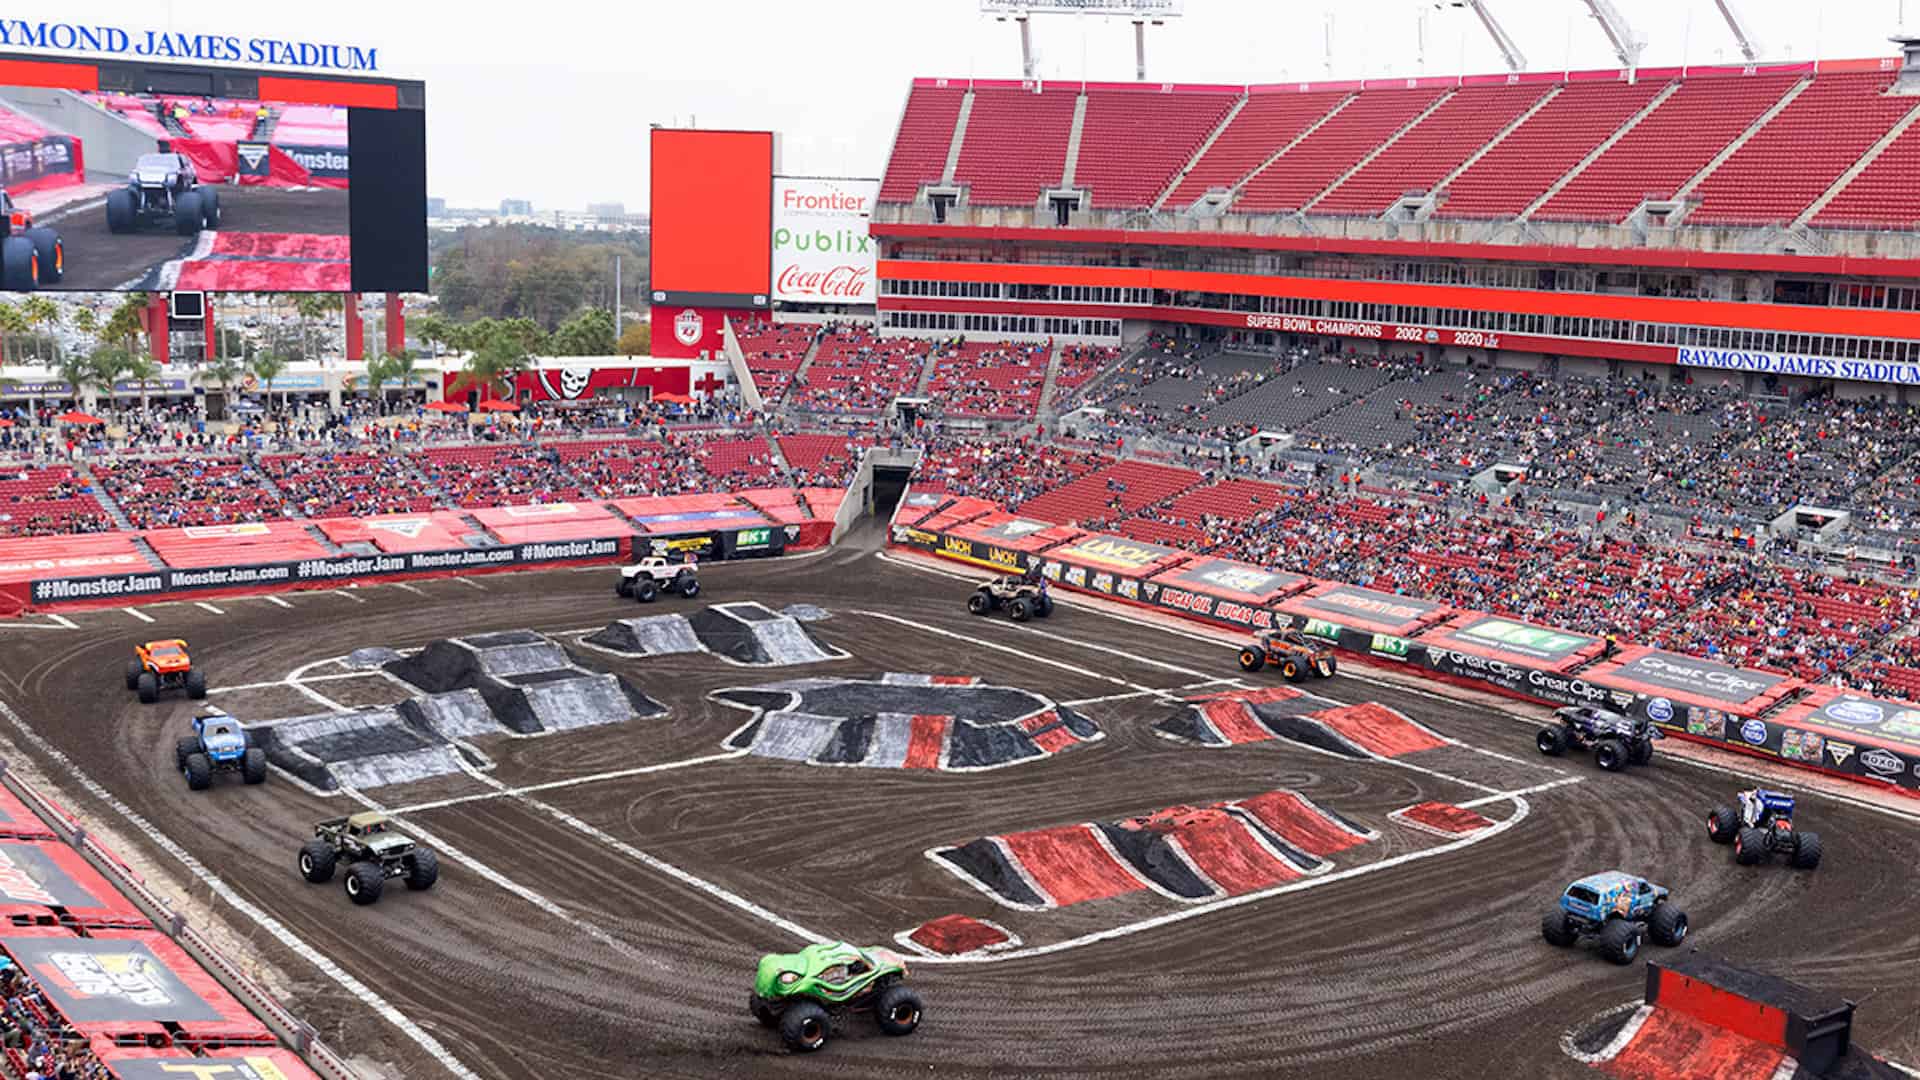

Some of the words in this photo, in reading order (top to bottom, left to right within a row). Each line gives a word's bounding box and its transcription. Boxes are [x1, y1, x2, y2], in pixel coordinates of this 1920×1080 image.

[135, 30, 242, 62] JAMES
[248, 38, 378, 71] STADIUM
[783, 189, 867, 210] Frontier
[1247, 315, 1281, 329] SUPER
[1283, 318, 1314, 332] BOWL
[1316, 321, 1382, 337] CHAMPIONS
[1395, 326, 1423, 341] 2002
[1454, 331, 1483, 345] 2020
[1679, 348, 1771, 372] RAYMOND
[1773, 355, 1836, 376] JAMES
[522, 540, 616, 561] #MonsterJam
[737, 530, 770, 545] BKT
[412, 550, 514, 568] MonsterJam.com
[944, 535, 973, 557] UNOH
[989, 546, 1018, 567] UNOH
[171, 566, 289, 586] MonsterJam.com
[297, 556, 405, 577] #MonsterJam
[36, 575, 162, 600] #MonsterJam
[1160, 588, 1193, 609] LUCAS
[1192, 595, 1213, 614] OIL
[1215, 601, 1252, 623] LUCAS
[1252, 610, 1273, 628] OIL
[1450, 651, 1488, 670] Great
[1488, 660, 1524, 680] Clips
[1639, 657, 1704, 679] Great
[1705, 671, 1762, 694] Clips
[1528, 670, 1569, 692] Great
[1569, 679, 1607, 700] Clips
